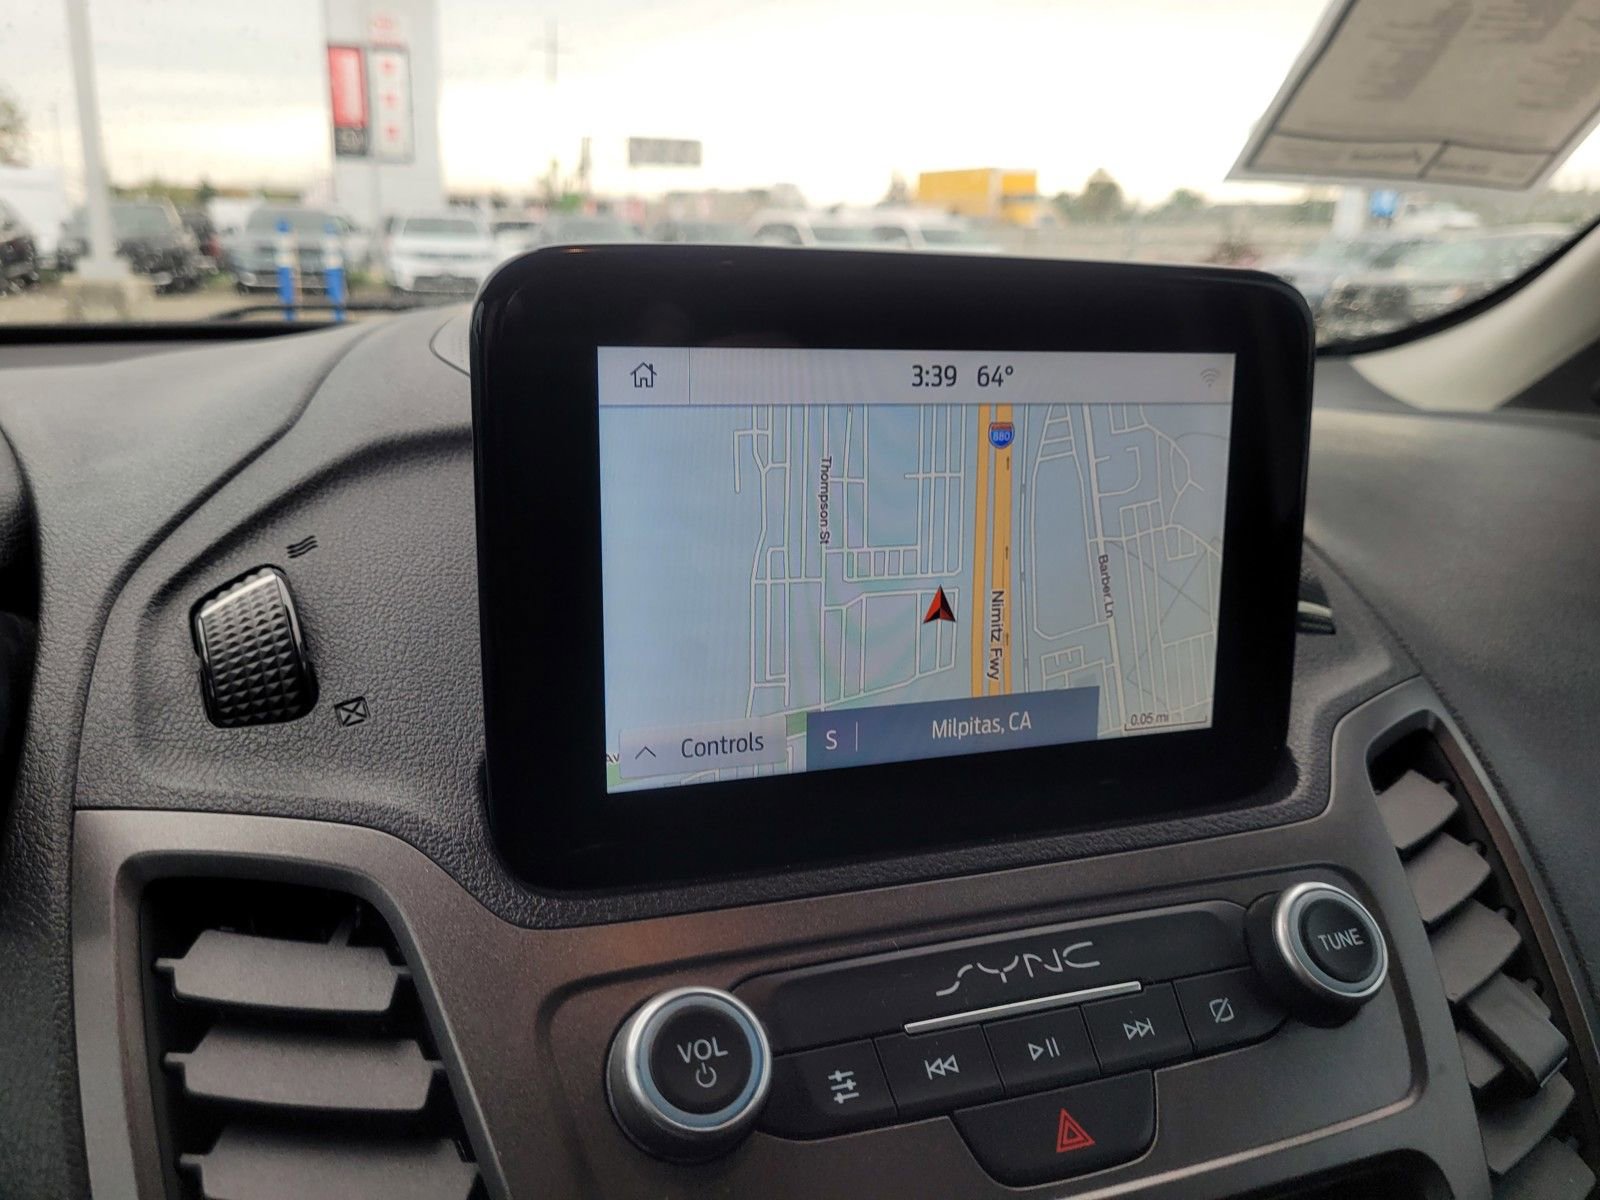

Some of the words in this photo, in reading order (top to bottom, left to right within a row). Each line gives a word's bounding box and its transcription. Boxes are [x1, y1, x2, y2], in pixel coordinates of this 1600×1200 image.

[912, 365, 957, 387] 3:39
[977, 365, 1014, 388] 64°
[993, 431, 1010, 441] 880
[818, 456, 832, 527] Thompson
[820, 531, 830, 544] St
[1098, 554, 1111, 598] Barber
[990, 590, 1004, 643] Nimitz
[1104, 601, 1114, 618] Ln
[987, 647, 1002, 680] Fwy
[932, 716, 1005, 740] Milpitas,
[1009, 711, 1032, 731] CA
[1131, 712, 1154, 726] 0.05
[1156, 713, 1169, 723] mi
[681, 732, 764, 758] Controls
[825, 729, 838, 750] S
[1317, 928, 1364, 951] TUNE
[936, 941, 1100, 996] SYNC
[677, 1036, 728, 1063] VOL
